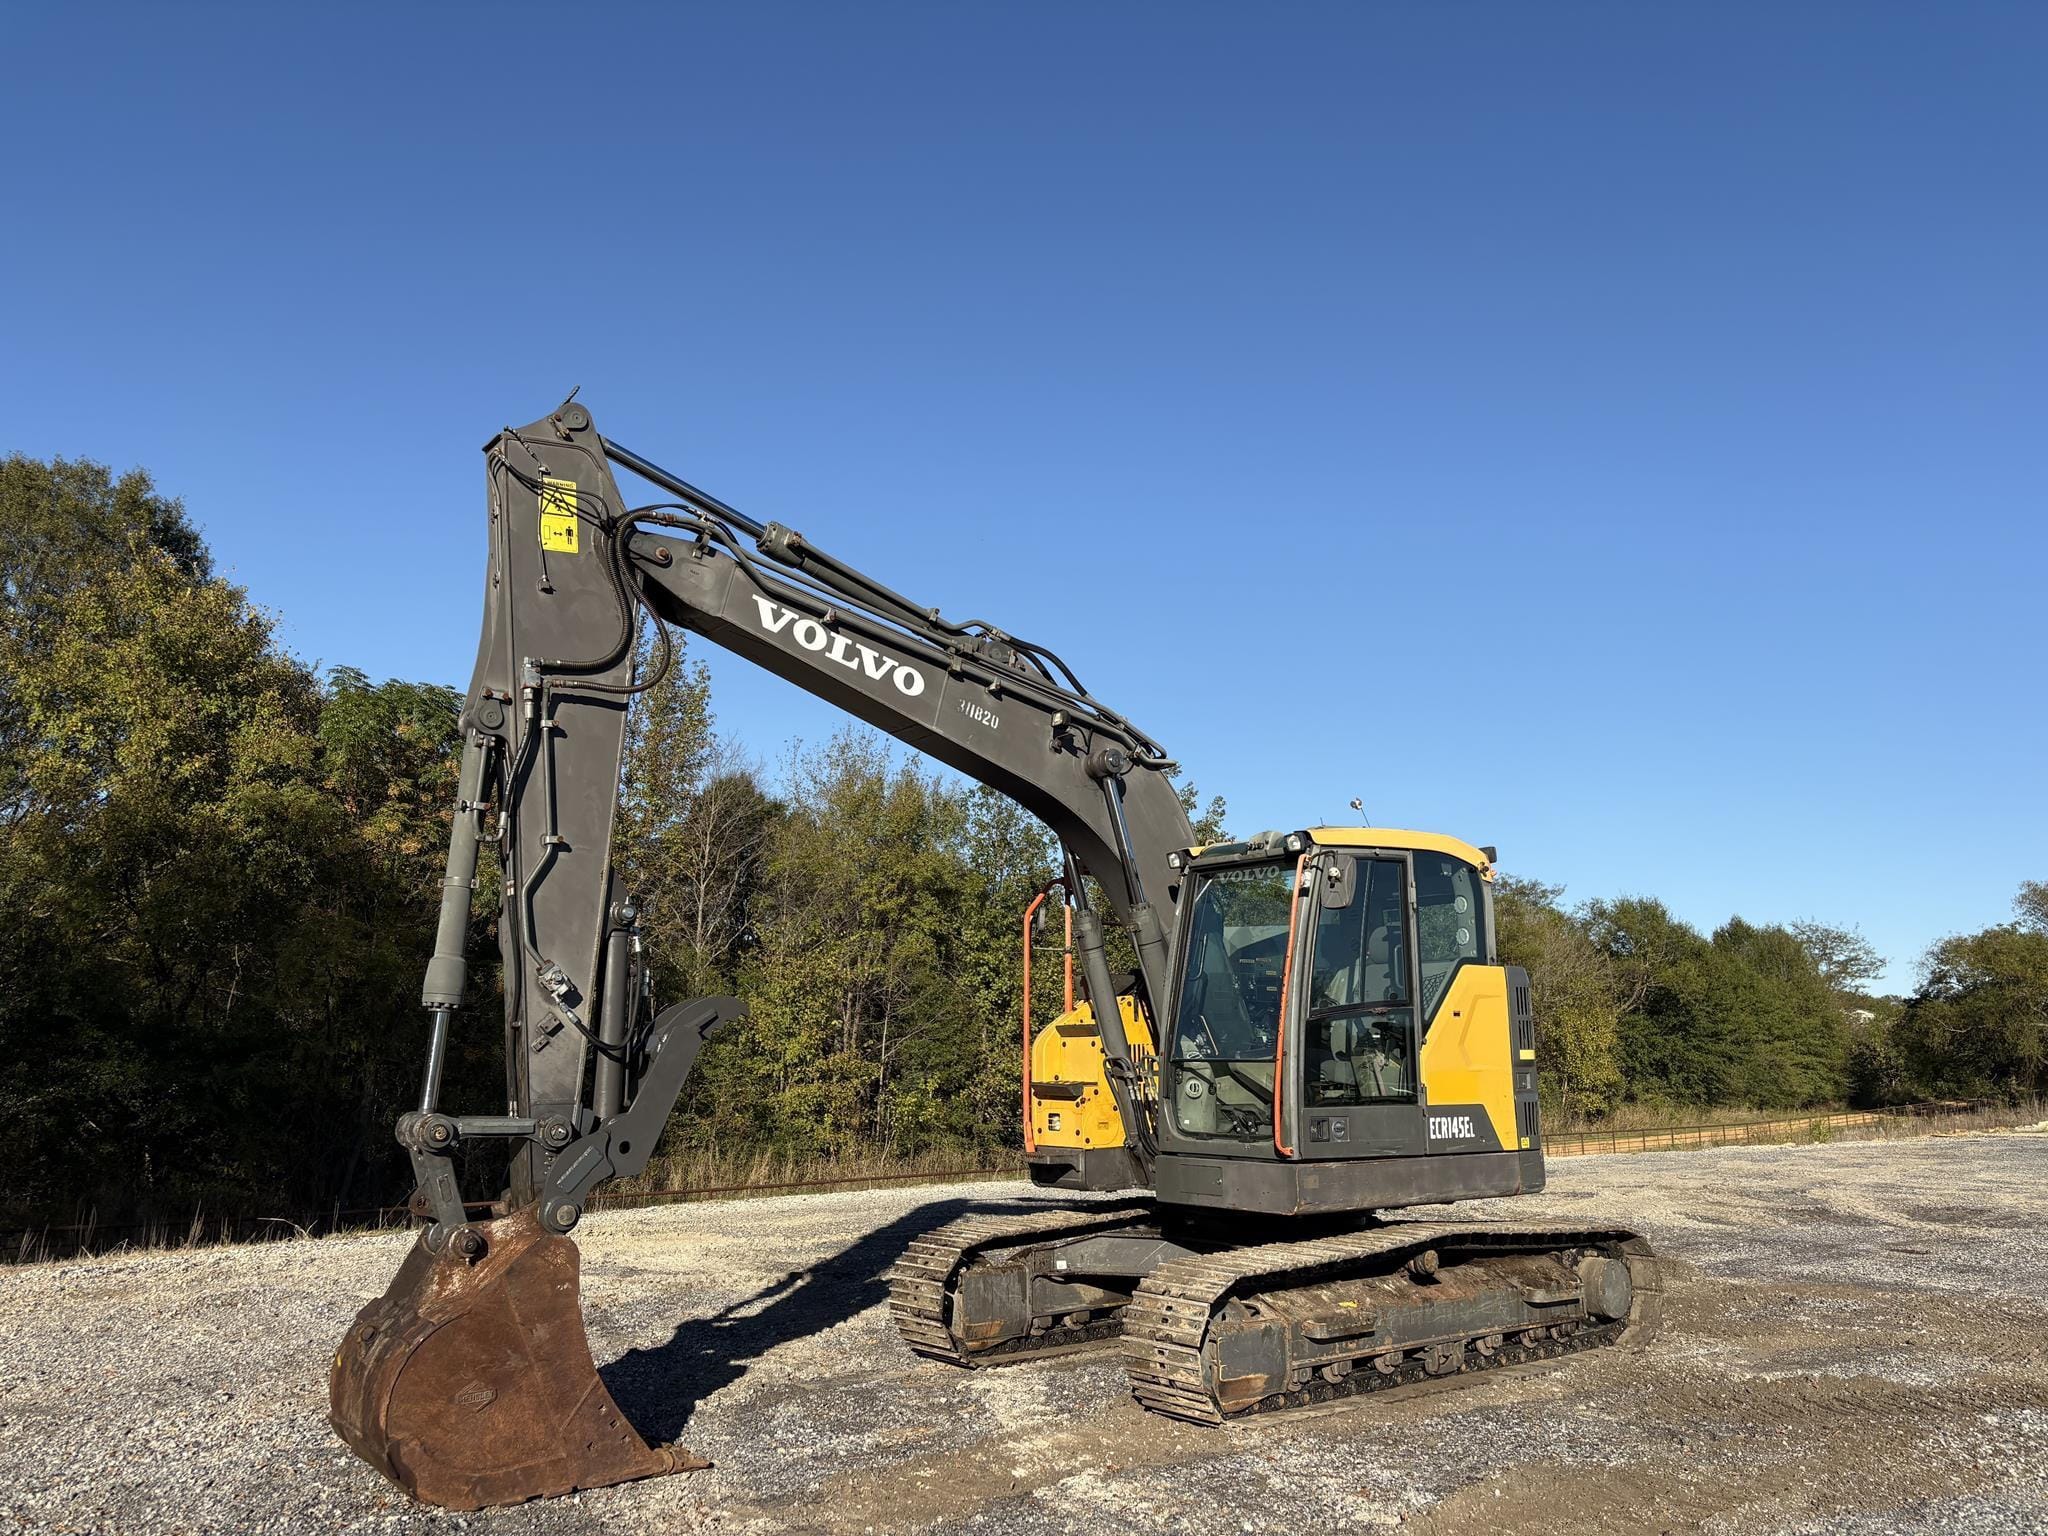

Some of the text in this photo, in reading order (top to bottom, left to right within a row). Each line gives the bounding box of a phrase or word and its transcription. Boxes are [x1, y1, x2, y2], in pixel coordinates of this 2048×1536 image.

[752, 594, 925, 697] VOLVO
[1217, 865, 1280, 884] VOLVO
[1429, 1116, 1476, 1140] ECR145EL
